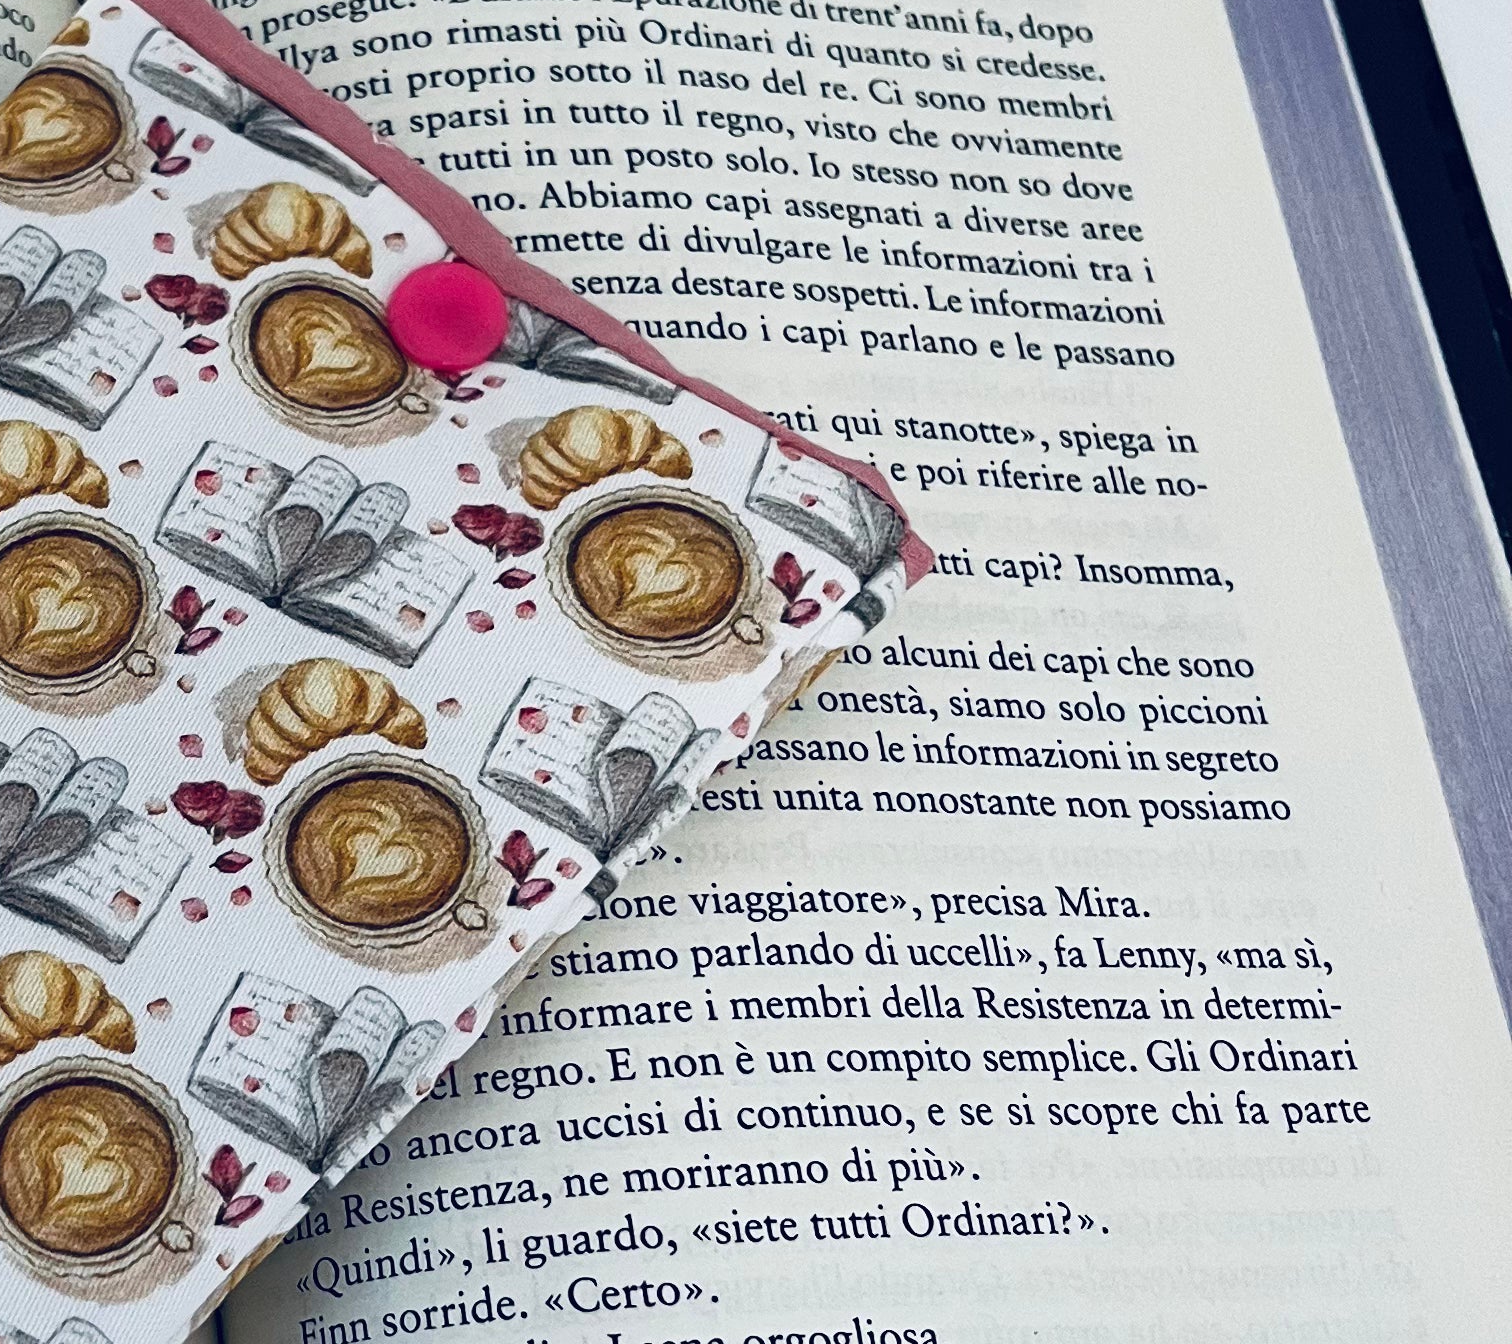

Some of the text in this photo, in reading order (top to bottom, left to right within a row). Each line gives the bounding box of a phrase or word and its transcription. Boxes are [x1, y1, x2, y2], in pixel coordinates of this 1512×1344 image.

[351, 30, 433, 58] sono
[446, 15, 563, 46] rimasti
[574, 16, 628, 49] più
[638, 18, 775, 55] Ordinari
[785, 30, 816, 59] di
[826, 43, 931, 70] quanto
[941, 46, 967, 73] si
[976, 50, 1106, 83] credesse.
[438, 140, 1134, 202] tutti in un posto solo. Io stesso non so dove
[889, 457, 1209, 498] e poi riferire alle no-
[816, 683, 1270, 732] onestà, siamo solo piccioni
[550, 941, 679, 978] stiamo
[689, 930, 855, 979] parlando
[864, 931, 900, 969] di
[1053, 933, 1088, 969] fa
[1092, 936, 1208, 979] Lenny,
[1293, 937, 1333, 978] sì,
[406, 1089, 1372, 1161] ancora uccisi di continuo, e se si scopre chi fa parte
[481, 1226, 511, 1265] li
[522, 1213, 678, 1270] guardo,
[809, 1203, 892, 1241] tutti
